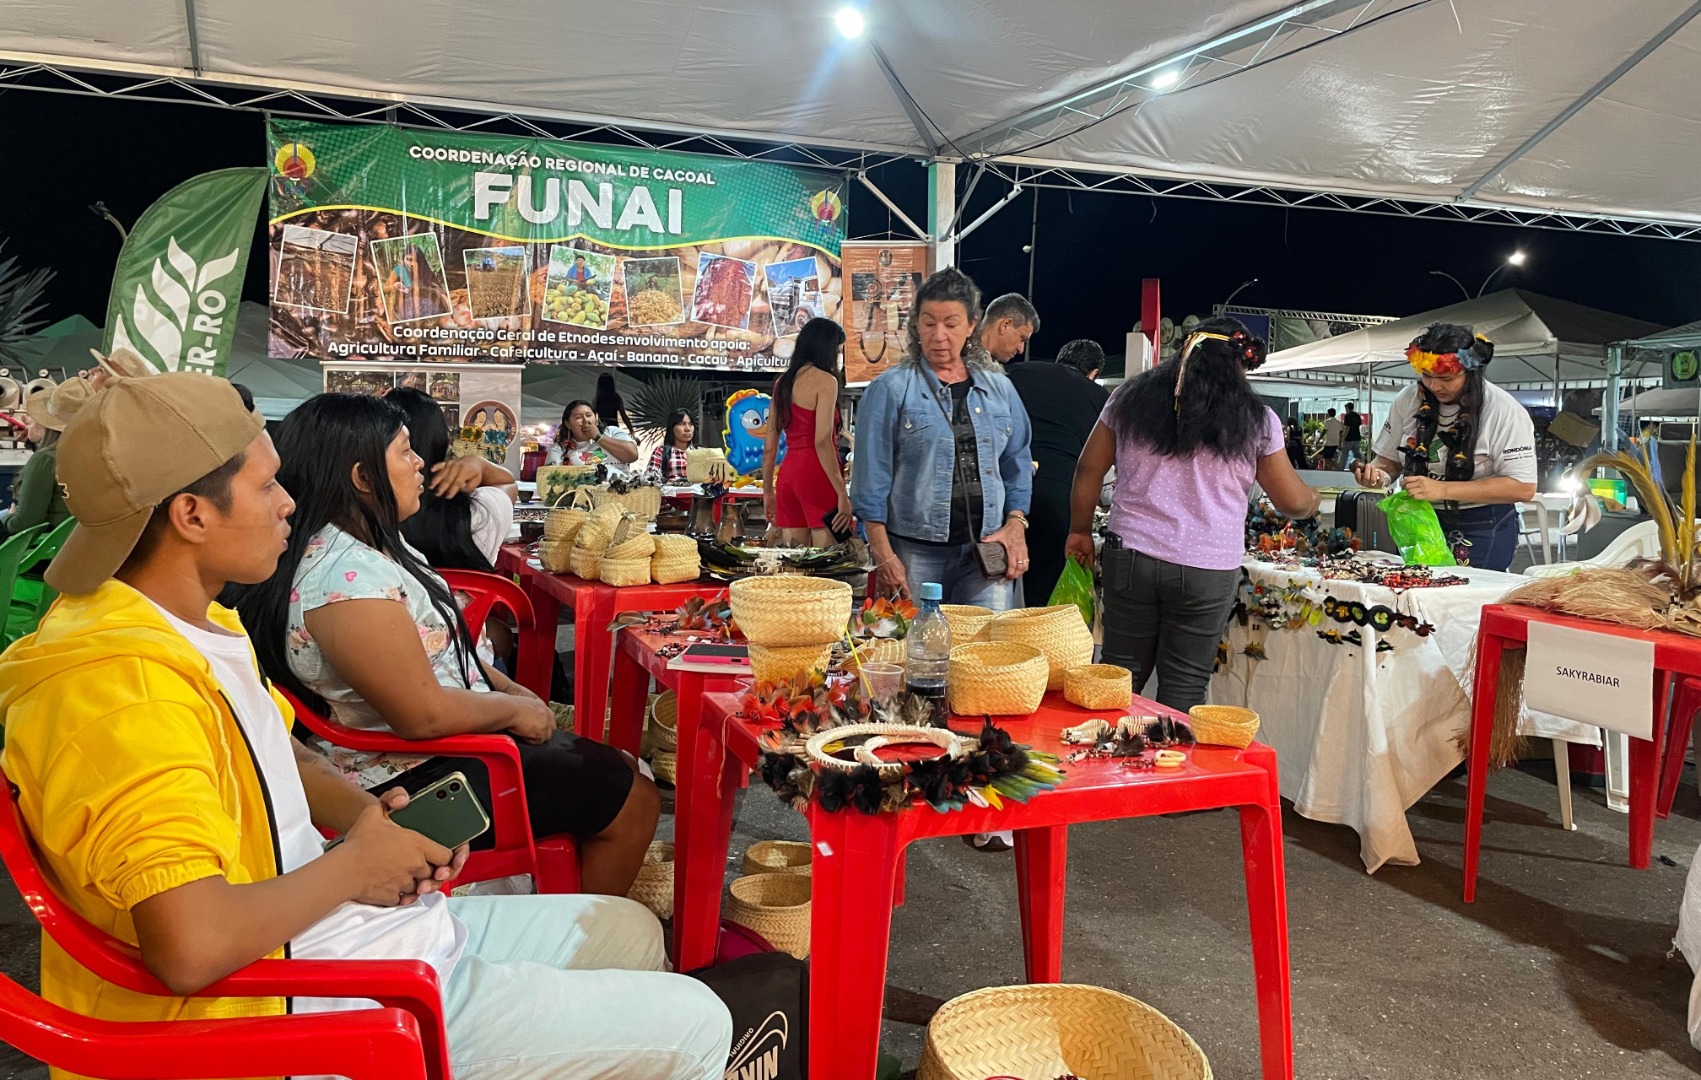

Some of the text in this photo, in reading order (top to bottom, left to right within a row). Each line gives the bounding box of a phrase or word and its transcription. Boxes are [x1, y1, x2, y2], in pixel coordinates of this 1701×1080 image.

[409, 145, 716, 185] COORDENAÇÃO REGIONAL DE CACOAL
[474, 171, 683, 235] FUNAI
[393, 326, 750, 351] Coordenação Geral de Etnodesenvolvimento apoia:
[328, 342, 416, 357] Agricultura
[419, 344, 480, 357] Familiar
[490, 346, 578, 360] Cafeicultura
[587, 349, 618, 363] Açaí
[626, 351, 679, 364] Banana
[688, 354, 728, 366] Cacau
[1556, 666, 1620, 688] SAKYRABIAR
